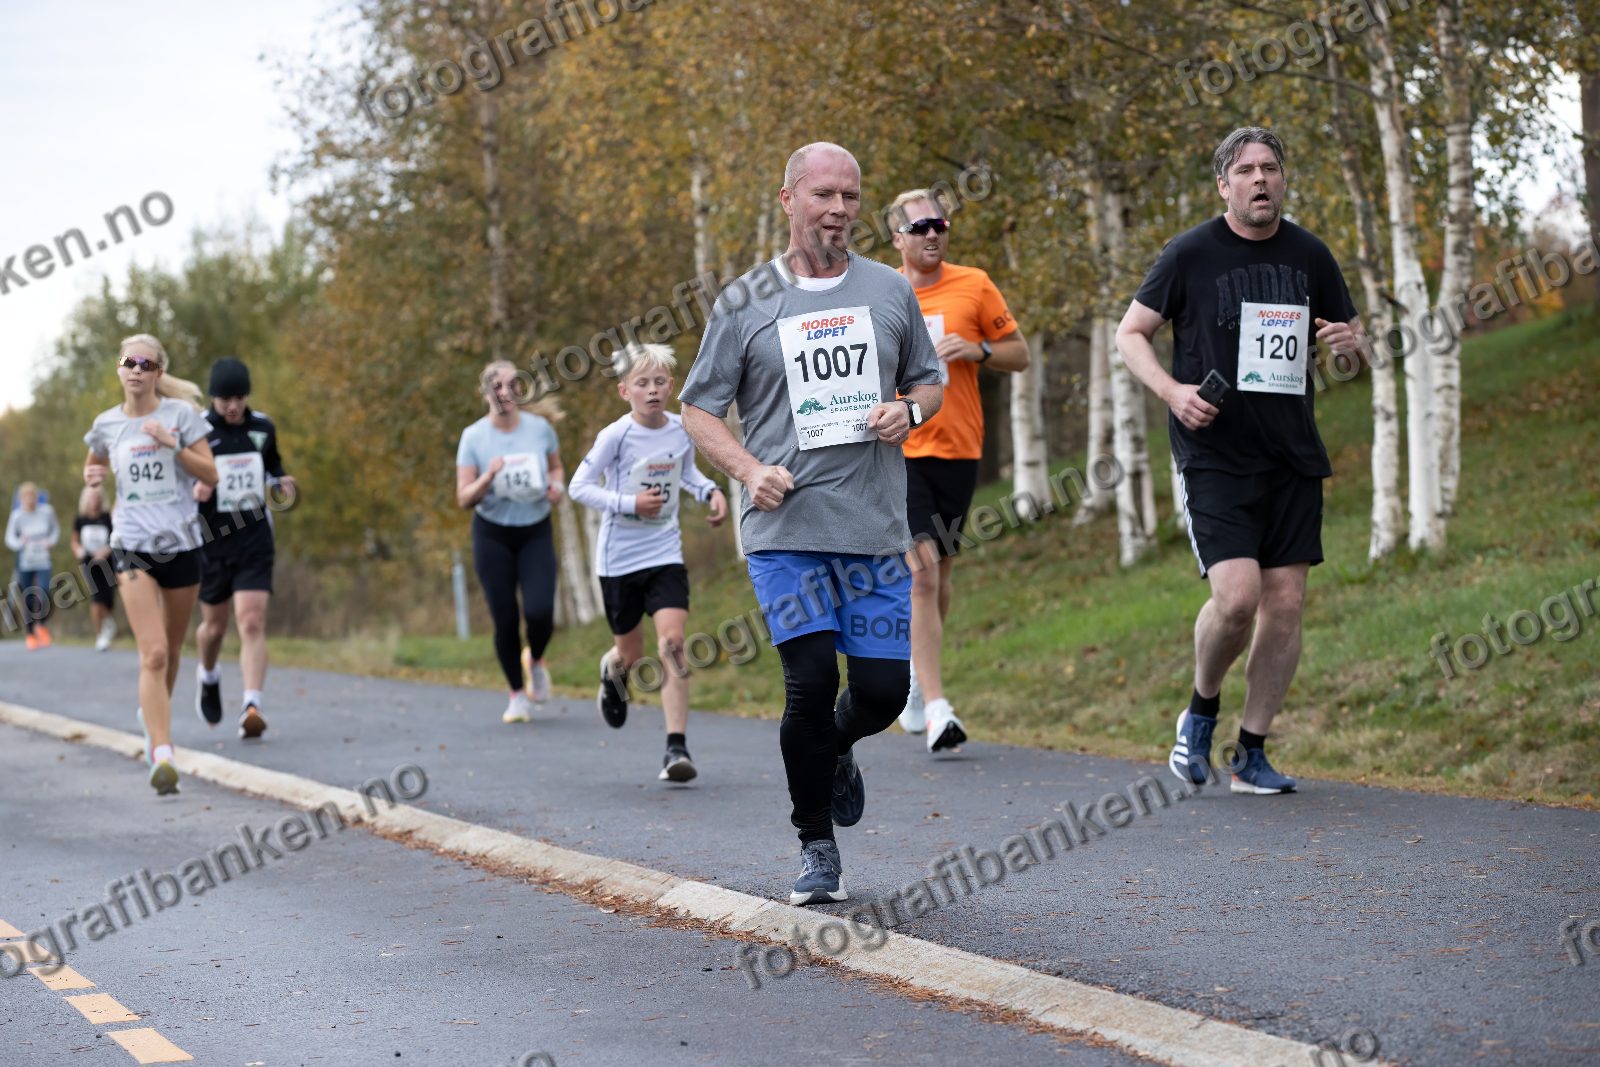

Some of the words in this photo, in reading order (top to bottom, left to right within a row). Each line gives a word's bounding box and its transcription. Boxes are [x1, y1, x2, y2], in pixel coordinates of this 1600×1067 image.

[1259, 310, 1302, 320] NORGES
[801, 316, 855, 331] NORGES
[1261, 319, 1295, 328] LØPET
[807, 326, 847, 340] LØPET
[1256, 333, 1297, 361] 120
[794, 343, 867, 382] 1007
[1268, 372, 1304, 385] Aurskog
[830, 390, 878, 404] Aurskog
[830, 403, 871, 414] SPAREBANK
[806, 428, 824, 438] 1007
[129, 461, 164, 482] 942
[226, 472, 255, 491] 212
[504, 470, 530, 490] 142
[850, 614, 910, 641] BOR
